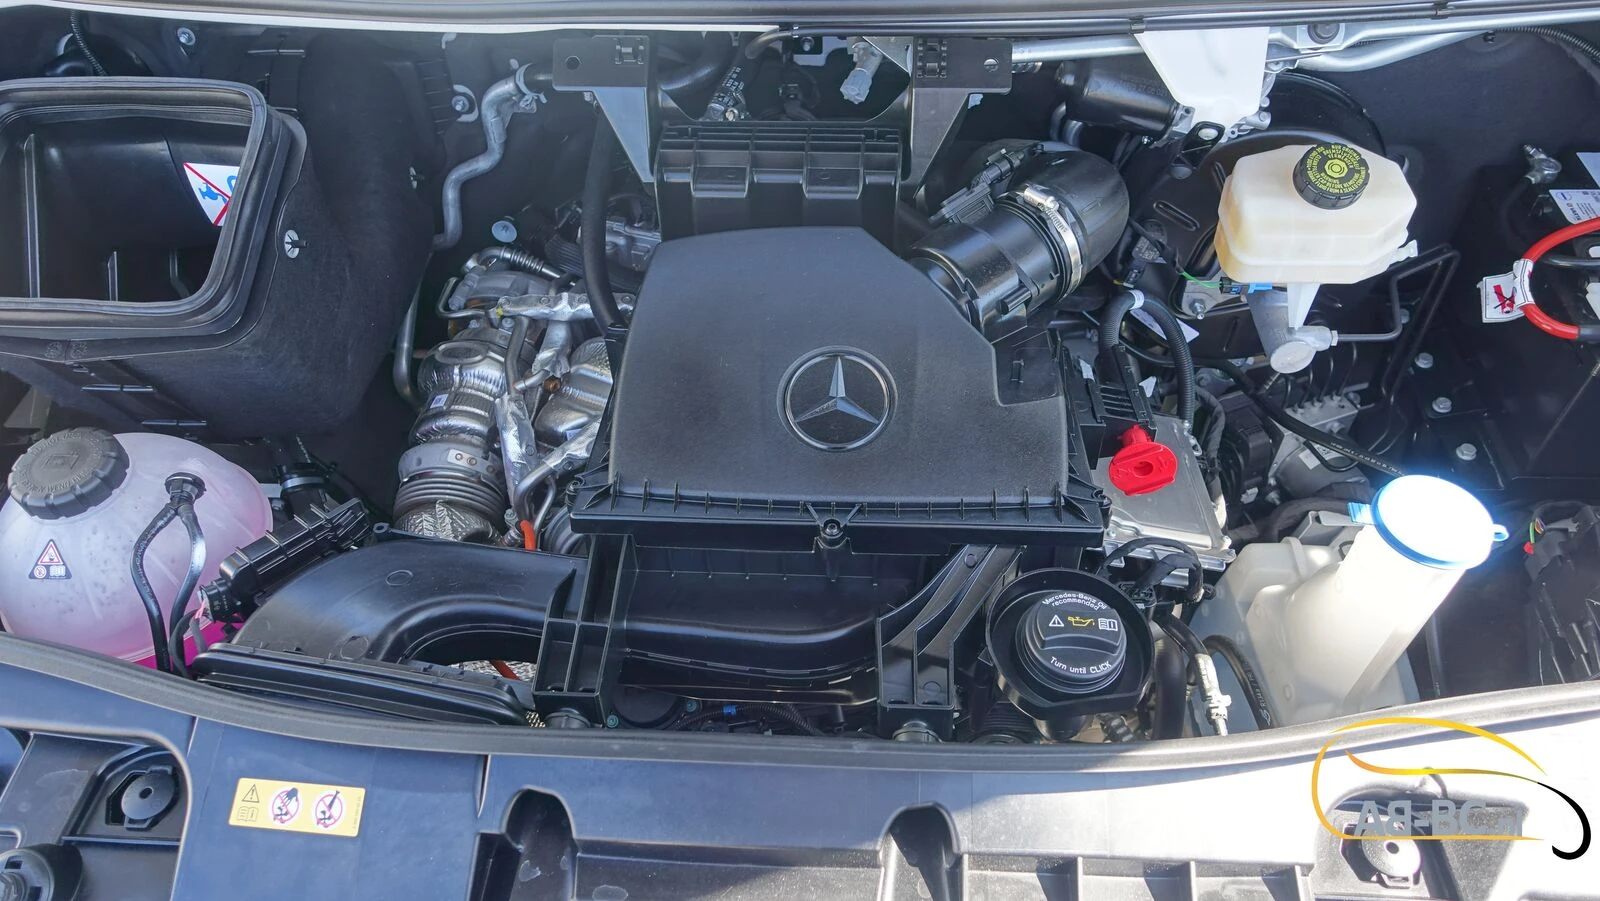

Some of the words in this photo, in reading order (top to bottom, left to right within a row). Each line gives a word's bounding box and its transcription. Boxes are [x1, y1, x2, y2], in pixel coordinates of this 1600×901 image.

[1042, 593, 1097, 605] Mercedes-Benz
[1097, 601, 1107, 610] Oil
[1052, 598, 1100, 611] recommended
[1050, 656, 1067, 670] Turn
[1089, 660, 1112, 674] CLICK
